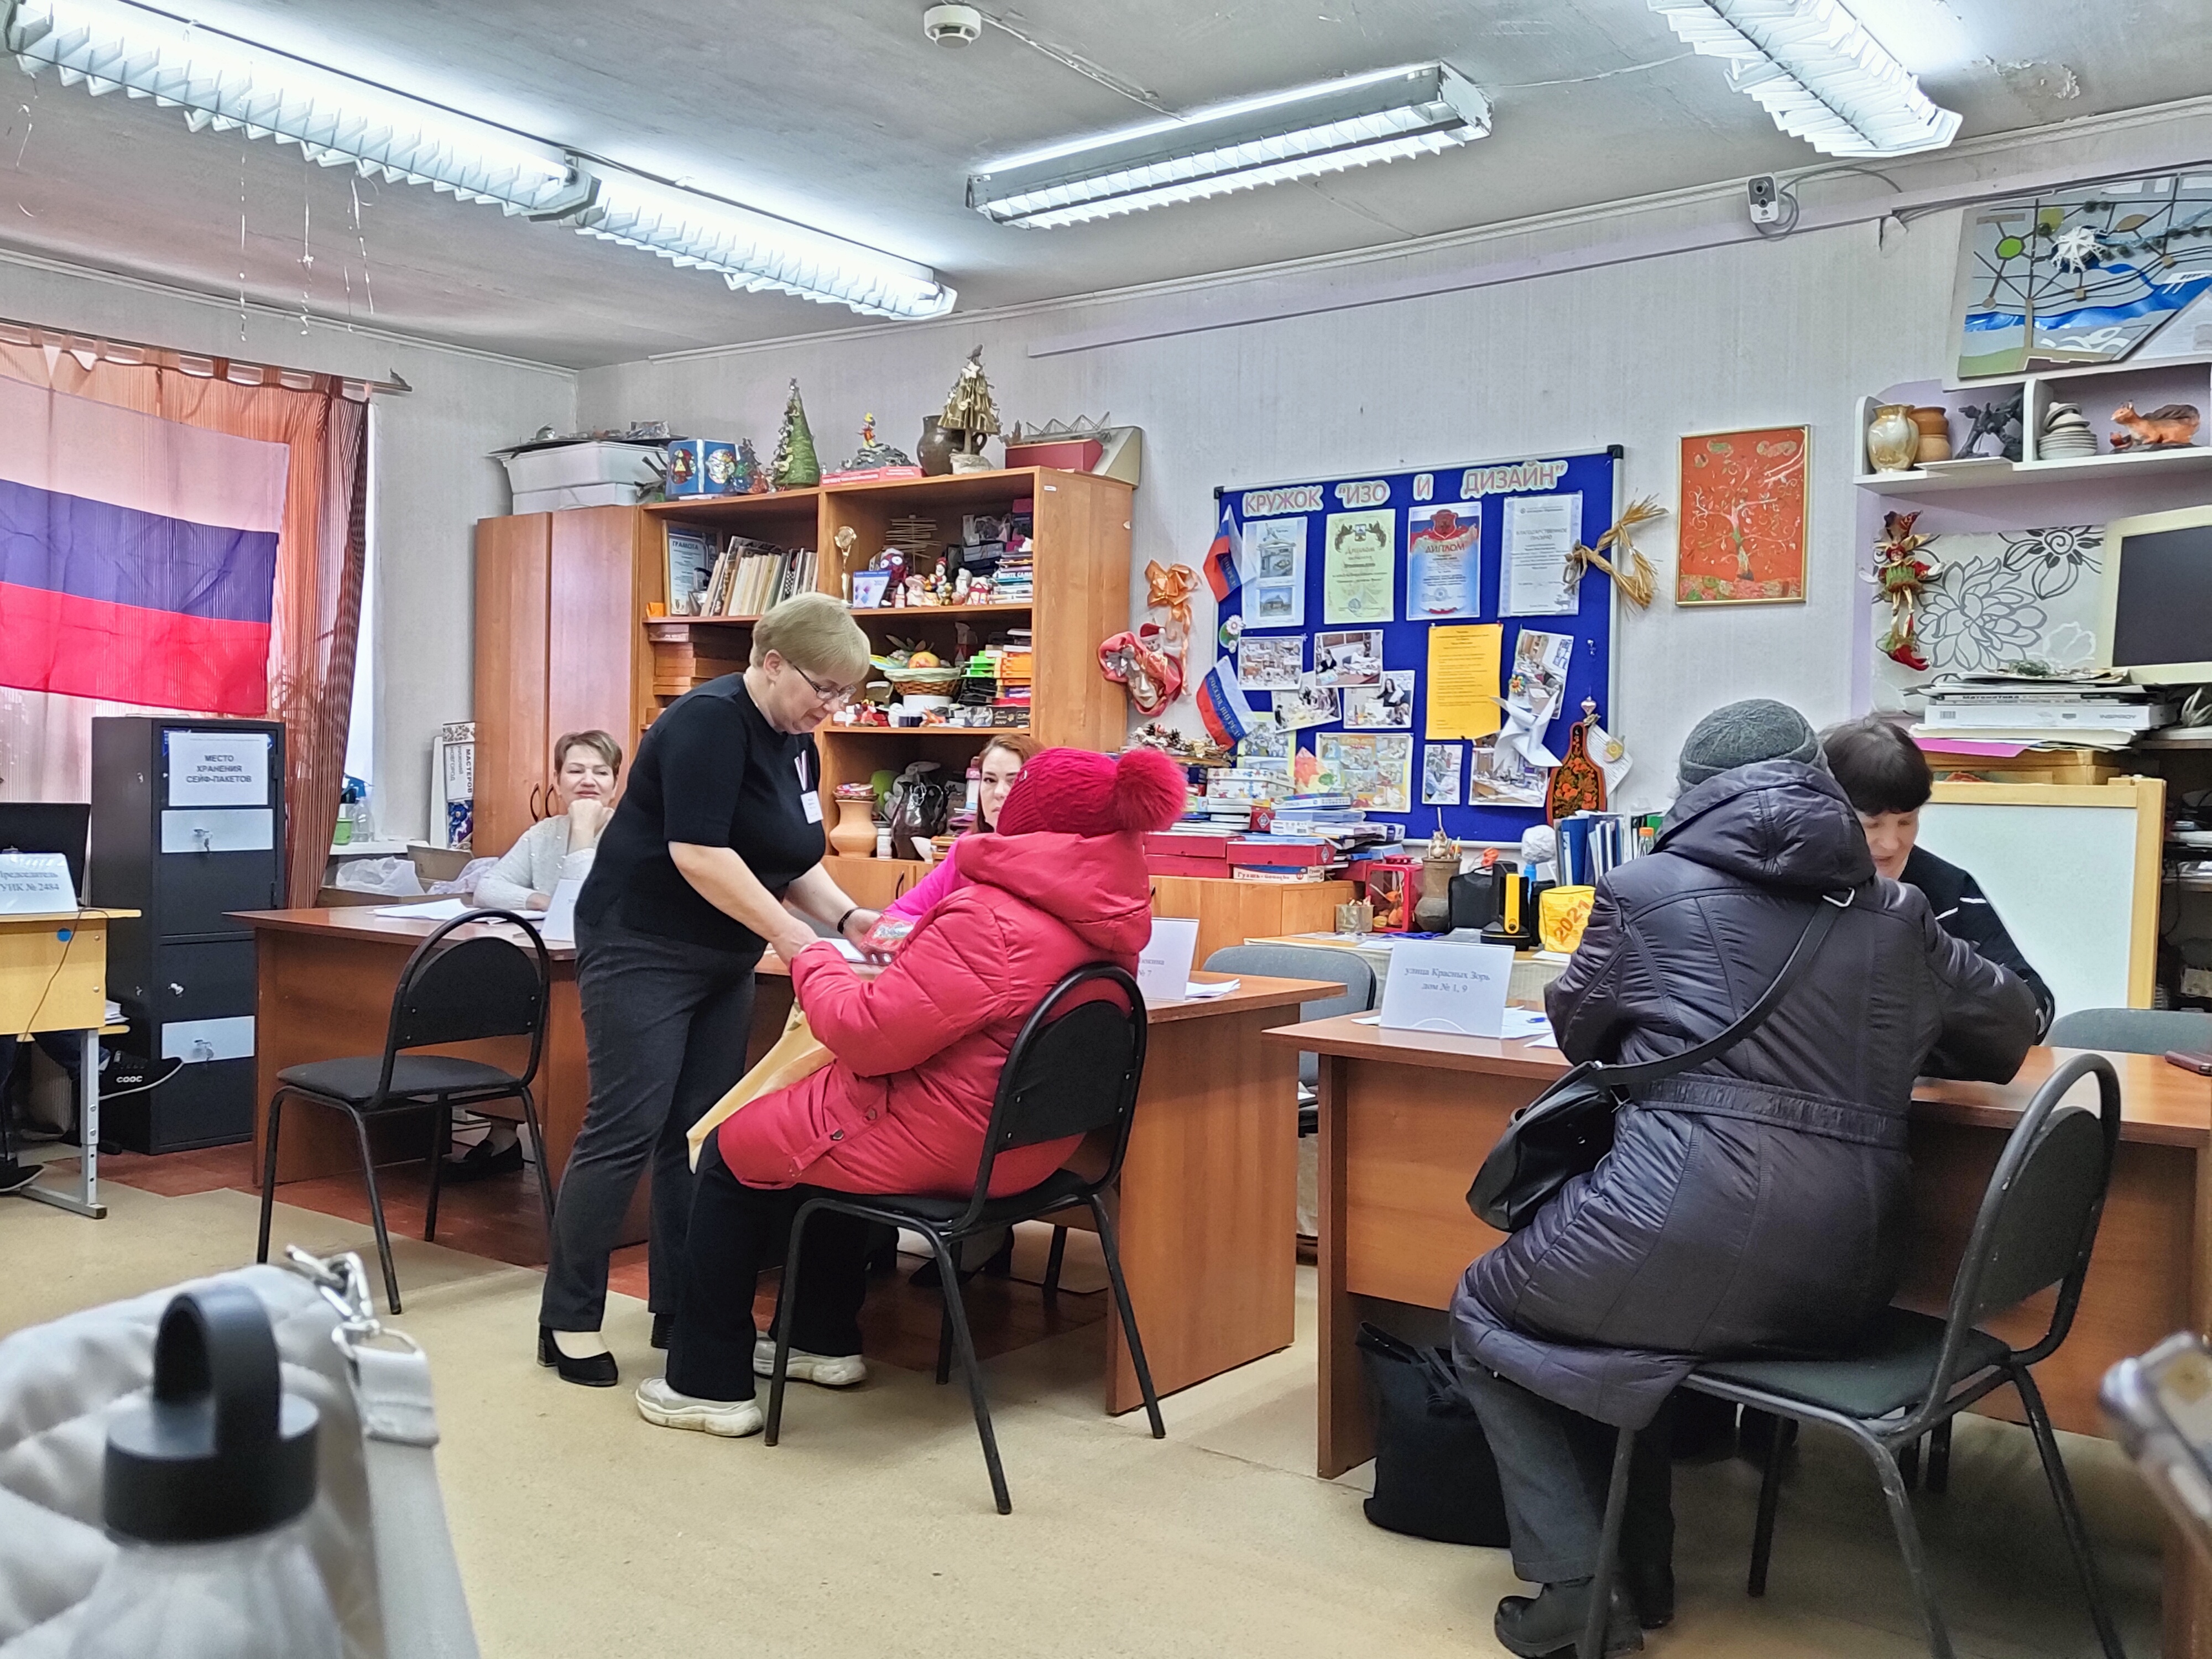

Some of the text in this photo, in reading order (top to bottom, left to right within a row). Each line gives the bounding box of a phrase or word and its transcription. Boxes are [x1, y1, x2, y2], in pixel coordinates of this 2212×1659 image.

[1244, 488, 1321, 514] КРУЖОК
[1416, 476, 1431, 497] И
[672, 540, 699, 550] ГРАМОТА
[1425, 542, 1465, 554] ДИПЛОМ
[186, 775, 253, 783] СЕЙФ-ПАКЕТОВ
[1553, 900, 1591, 945] 2021
[1432, 969, 1468, 978] Красных
[1470, 971, 1491, 982] Зорь
[1439, 983, 1450, 992] №
